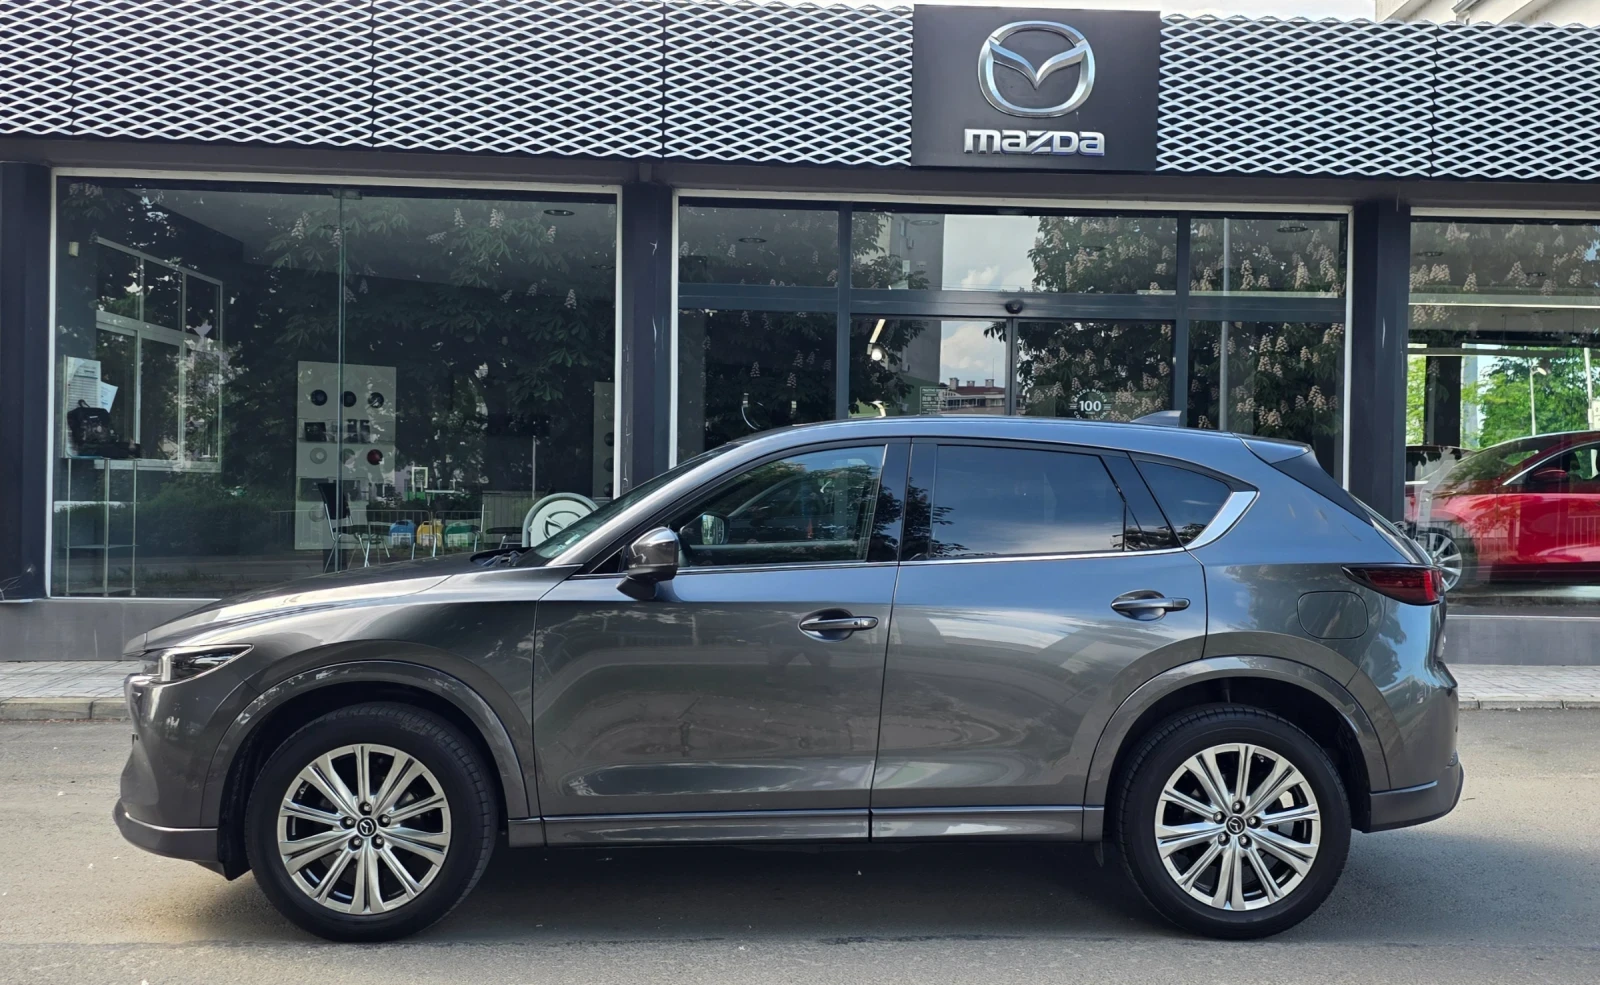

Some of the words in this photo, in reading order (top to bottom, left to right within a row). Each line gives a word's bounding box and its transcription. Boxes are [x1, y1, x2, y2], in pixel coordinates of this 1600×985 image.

[964, 128, 1105, 157] mazda
[1073, 388, 1090, 403] MAZDA
[1091, 388, 1108, 403] MOTOR
[1079, 400, 1102, 412] 100
